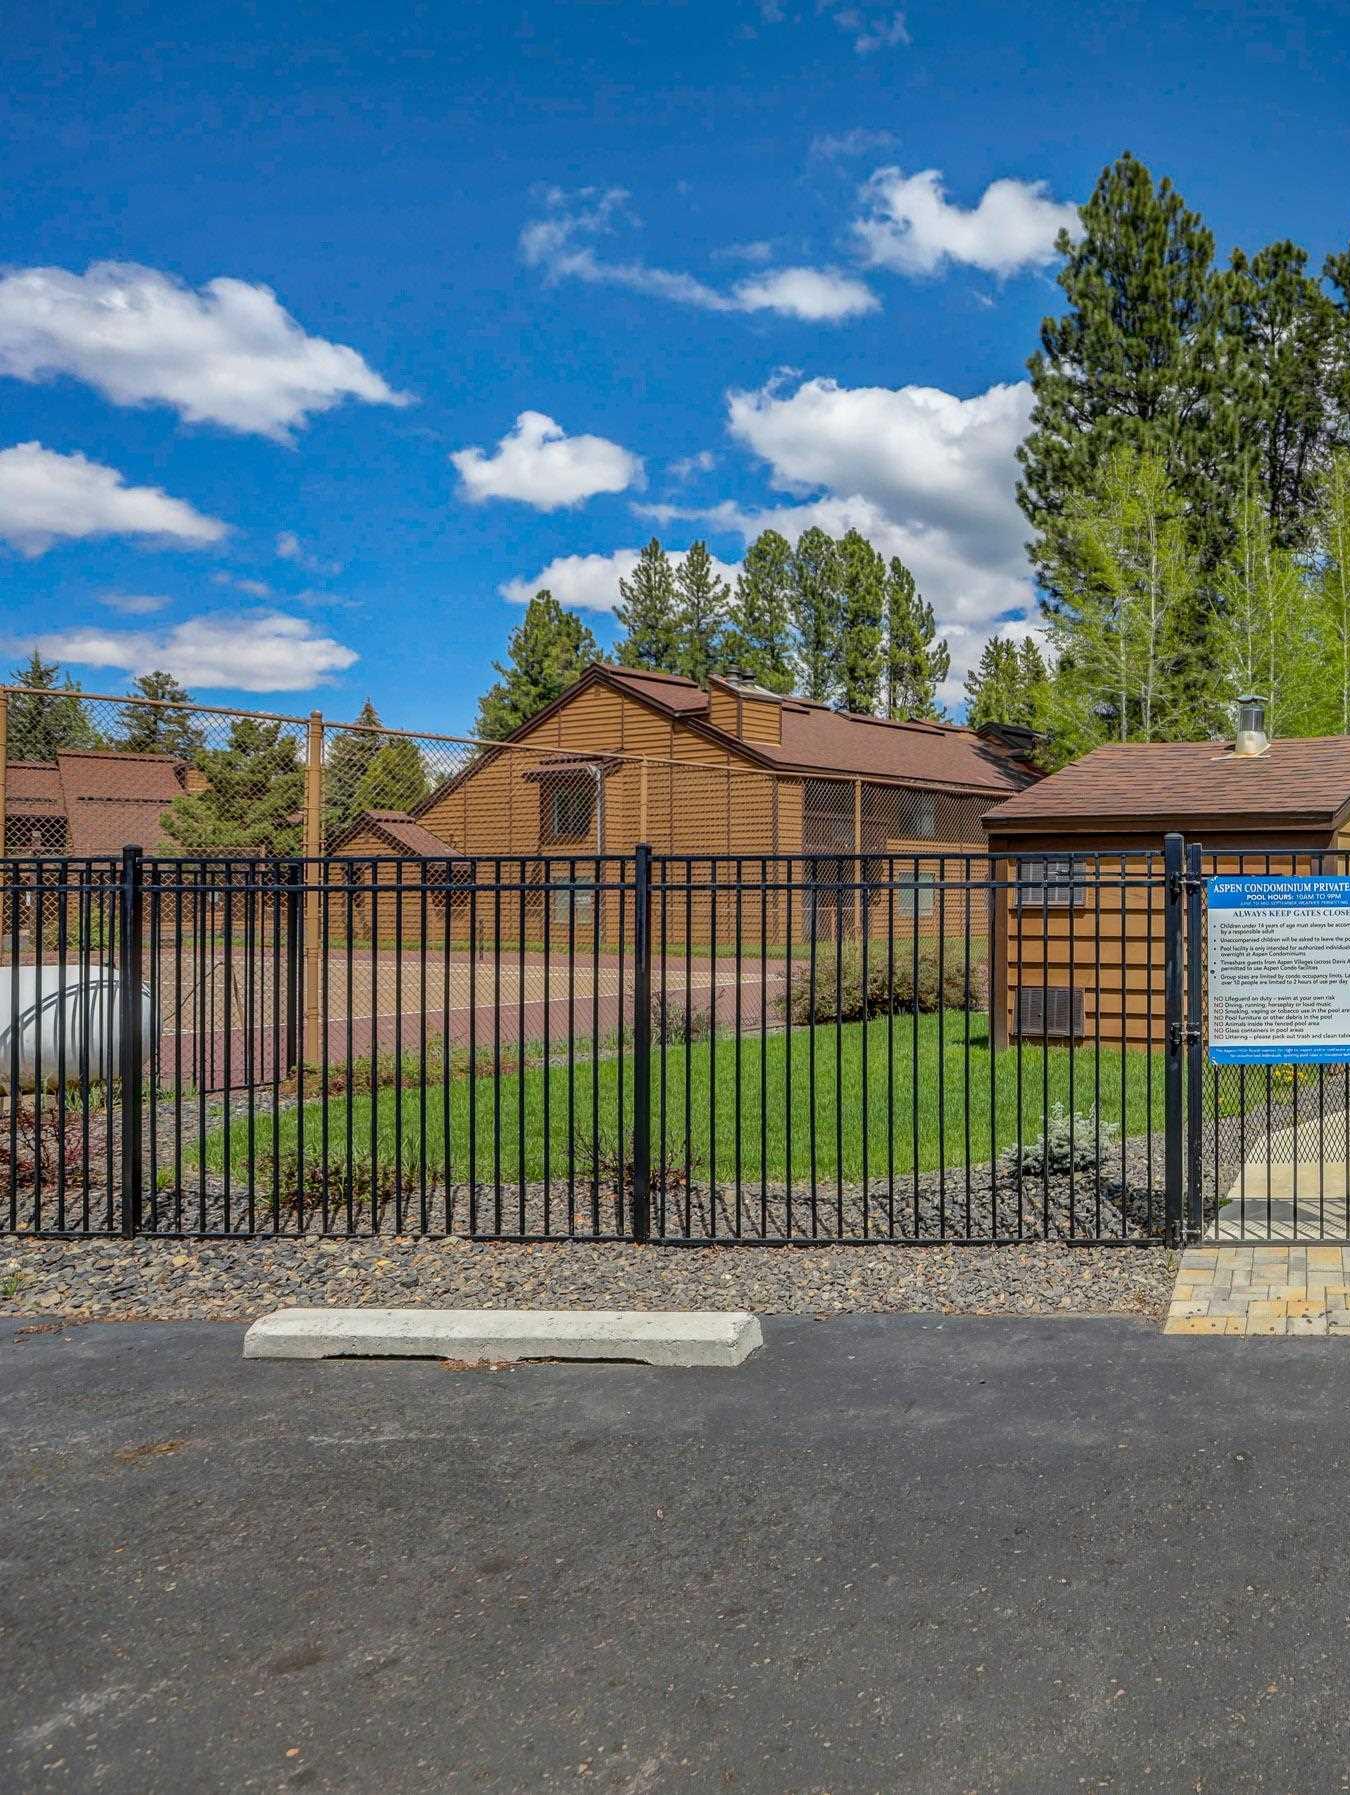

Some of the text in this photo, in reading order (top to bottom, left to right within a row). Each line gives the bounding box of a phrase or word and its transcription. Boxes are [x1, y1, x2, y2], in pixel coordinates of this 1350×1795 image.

[1214, 883, 1242, 893] ASPEN
[1245, 883, 1311, 892] CONDOMINIUM
[1314, 882, 1350, 892] PRIVATE
